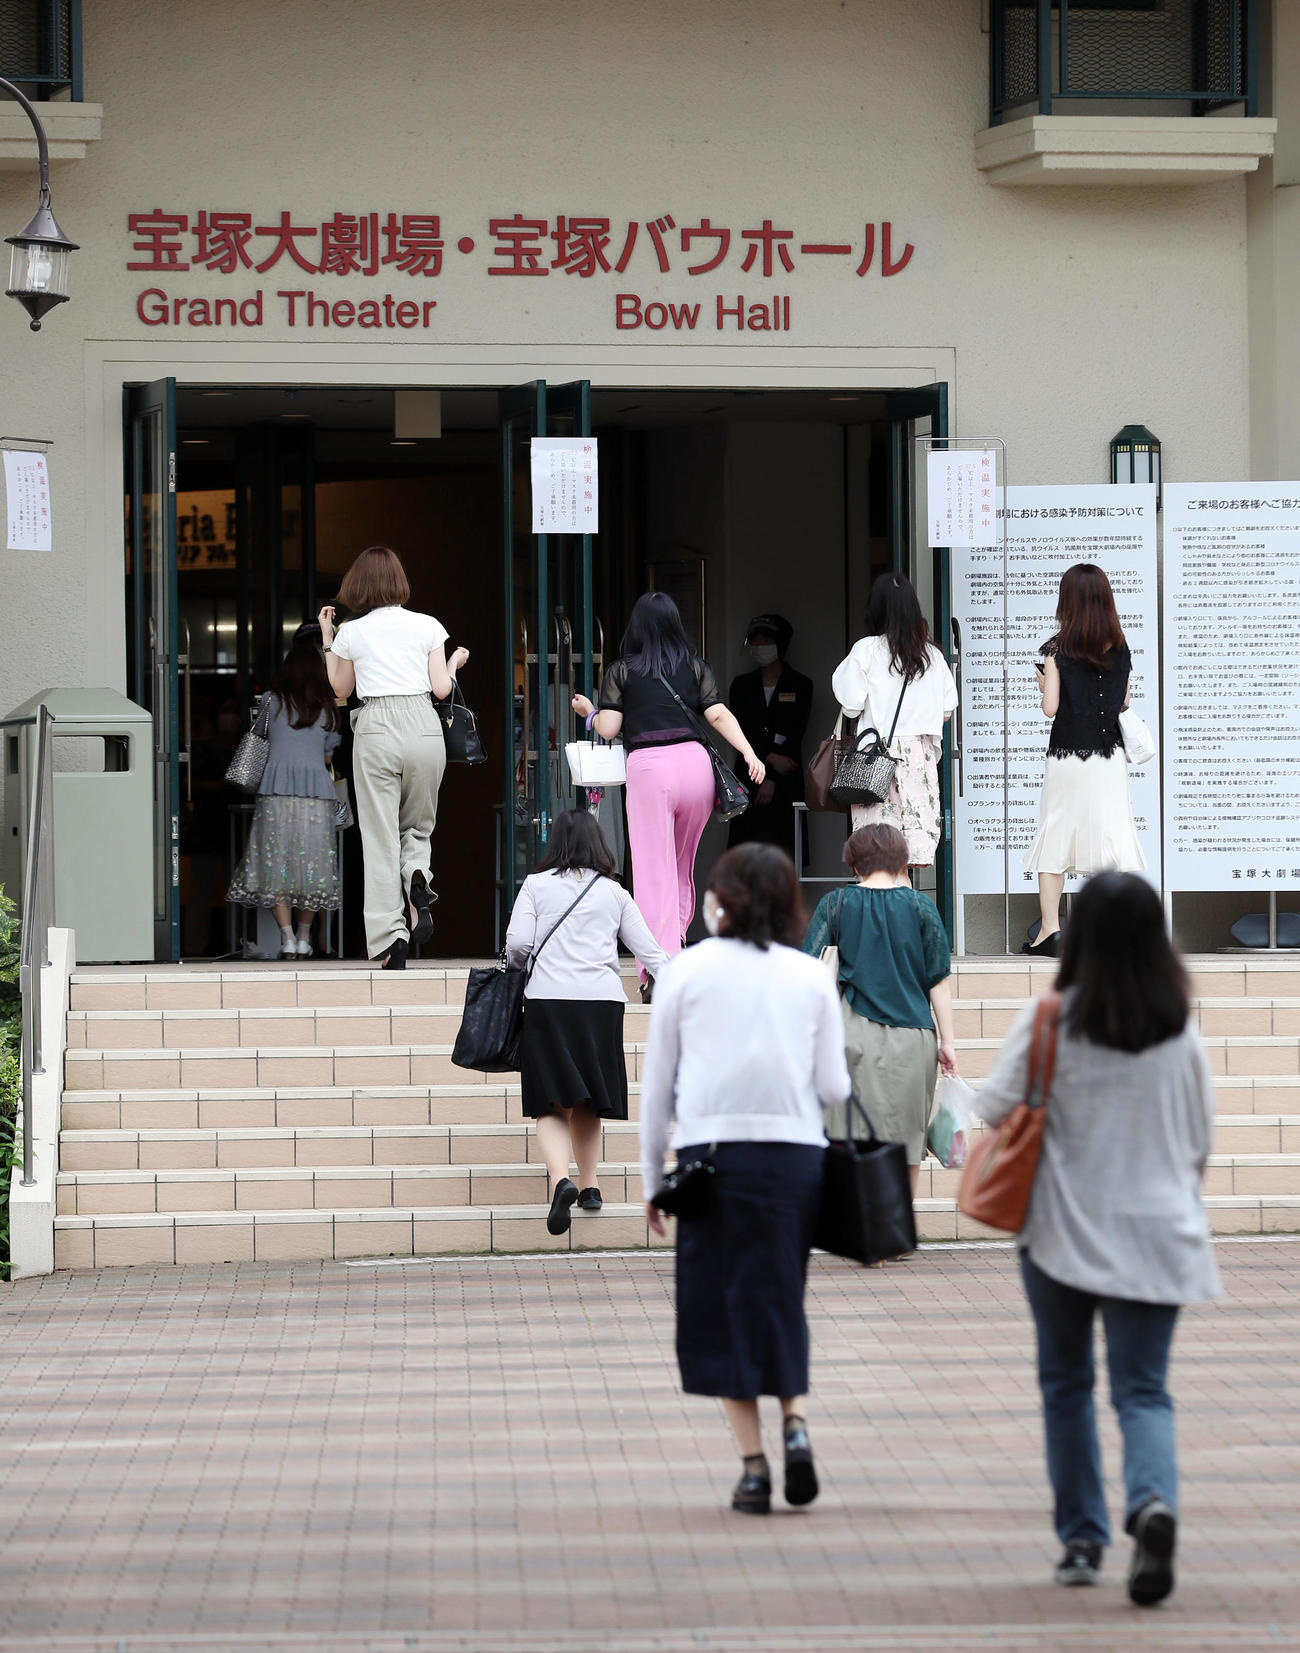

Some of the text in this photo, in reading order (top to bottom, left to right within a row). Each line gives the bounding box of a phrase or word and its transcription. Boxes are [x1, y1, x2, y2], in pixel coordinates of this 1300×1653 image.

[128, 209, 913, 277] 宝塚大劇場・宝塚バウホール
[138, 289, 436, 328] Grand Theater
[617, 294, 789, 330] Bow Hall
[583, 445, 592, 514] 検温実施中
[981, 457, 991, 528] 検温実施中
